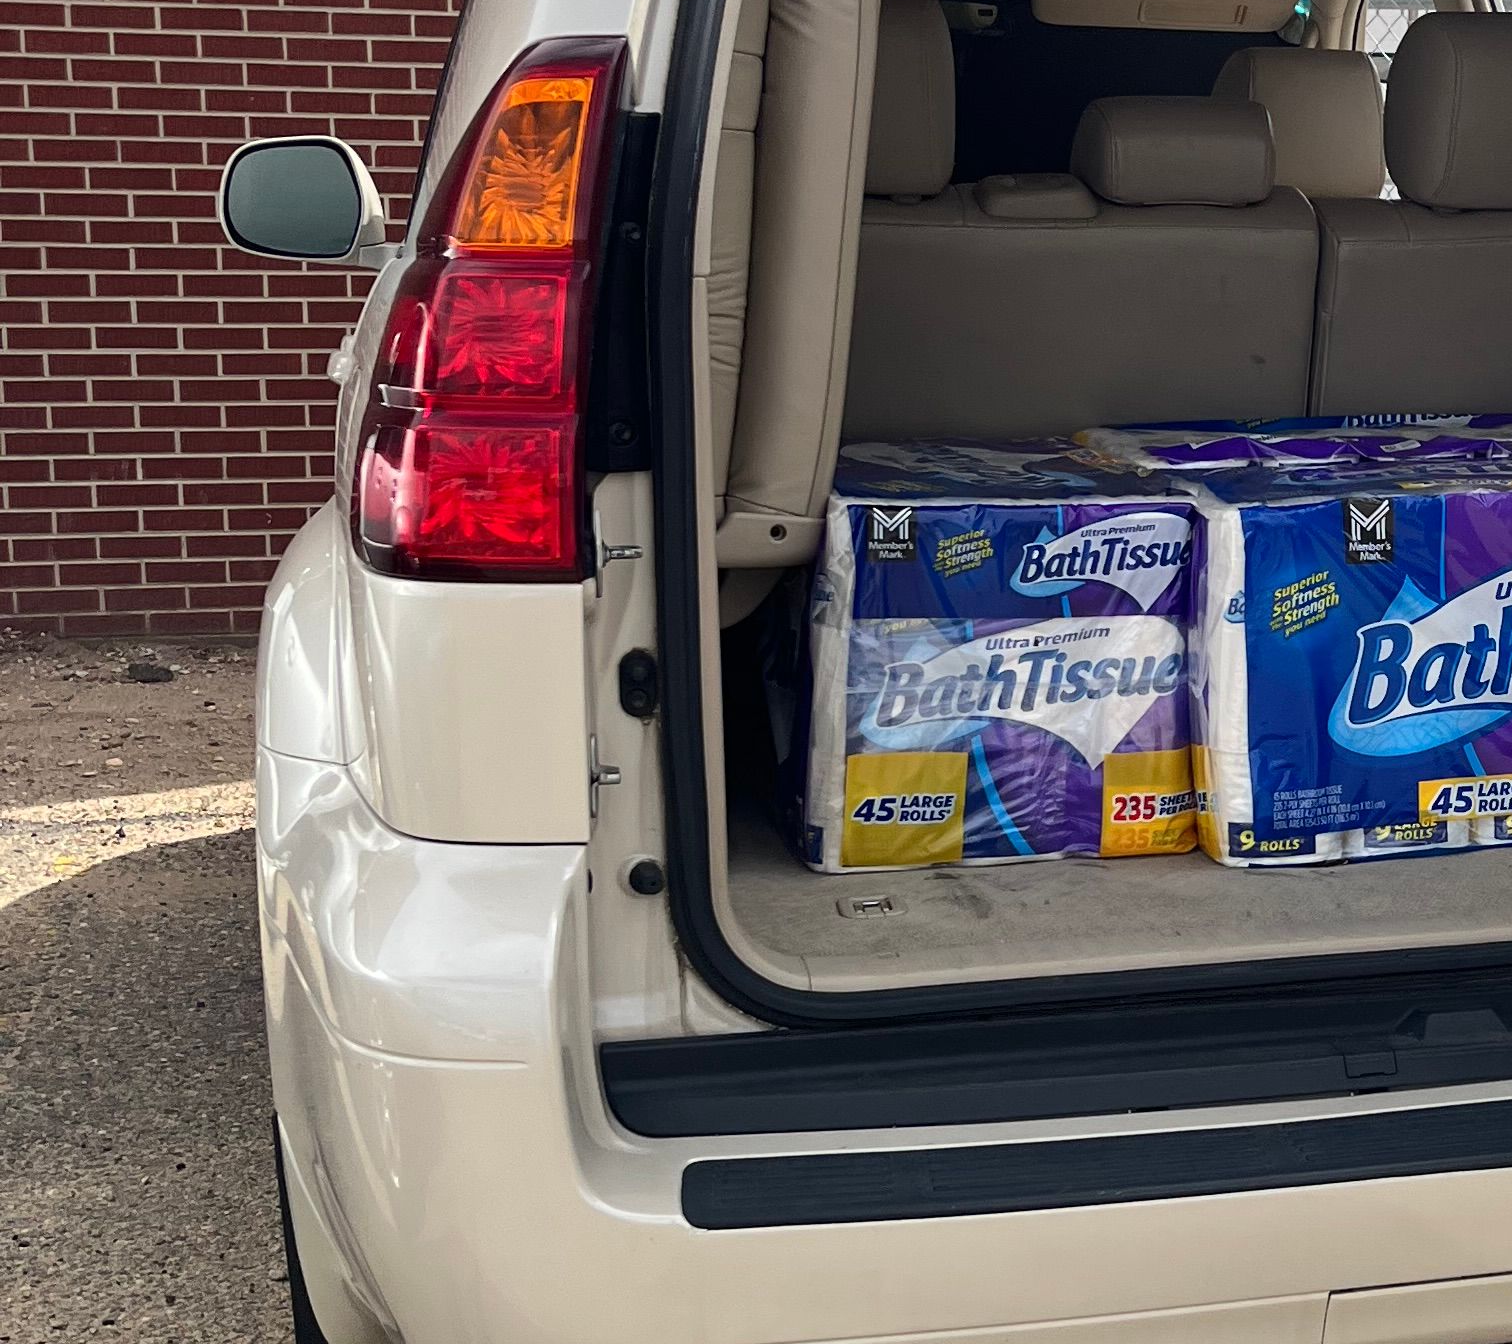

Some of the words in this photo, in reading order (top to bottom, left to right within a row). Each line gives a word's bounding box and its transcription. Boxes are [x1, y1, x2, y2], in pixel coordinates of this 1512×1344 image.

[937, 529, 985, 550] Superior
[1080, 525, 1107, 538] Ultra
[1108, 522, 1157, 536] Premium
[868, 541, 914, 550] Member's
[879, 550, 904, 560] Mark
[936, 538, 991, 562] Softness
[1349, 541, 1392, 551] Member's
[943, 548, 994, 570] Strength
[1274, 570, 1330, 601] Superior
[1272, 581, 1336, 618] Softness
[1284, 592, 1340, 626] Strength
[985, 637, 1030, 652] Ultra
[1033, 625, 1111, 648] Premium
[875, 648, 1183, 729] BathTissue
[853, 797, 897, 823] 45
[901, 794, 955, 809] LARGE
[1113, 795, 1156, 821] 235
[1159, 805, 1178, 816] PER
[1431, 785, 1475, 815] 45
[1239, 829, 1256, 851] 9
[1394, 827, 1434, 842] ROLLS
